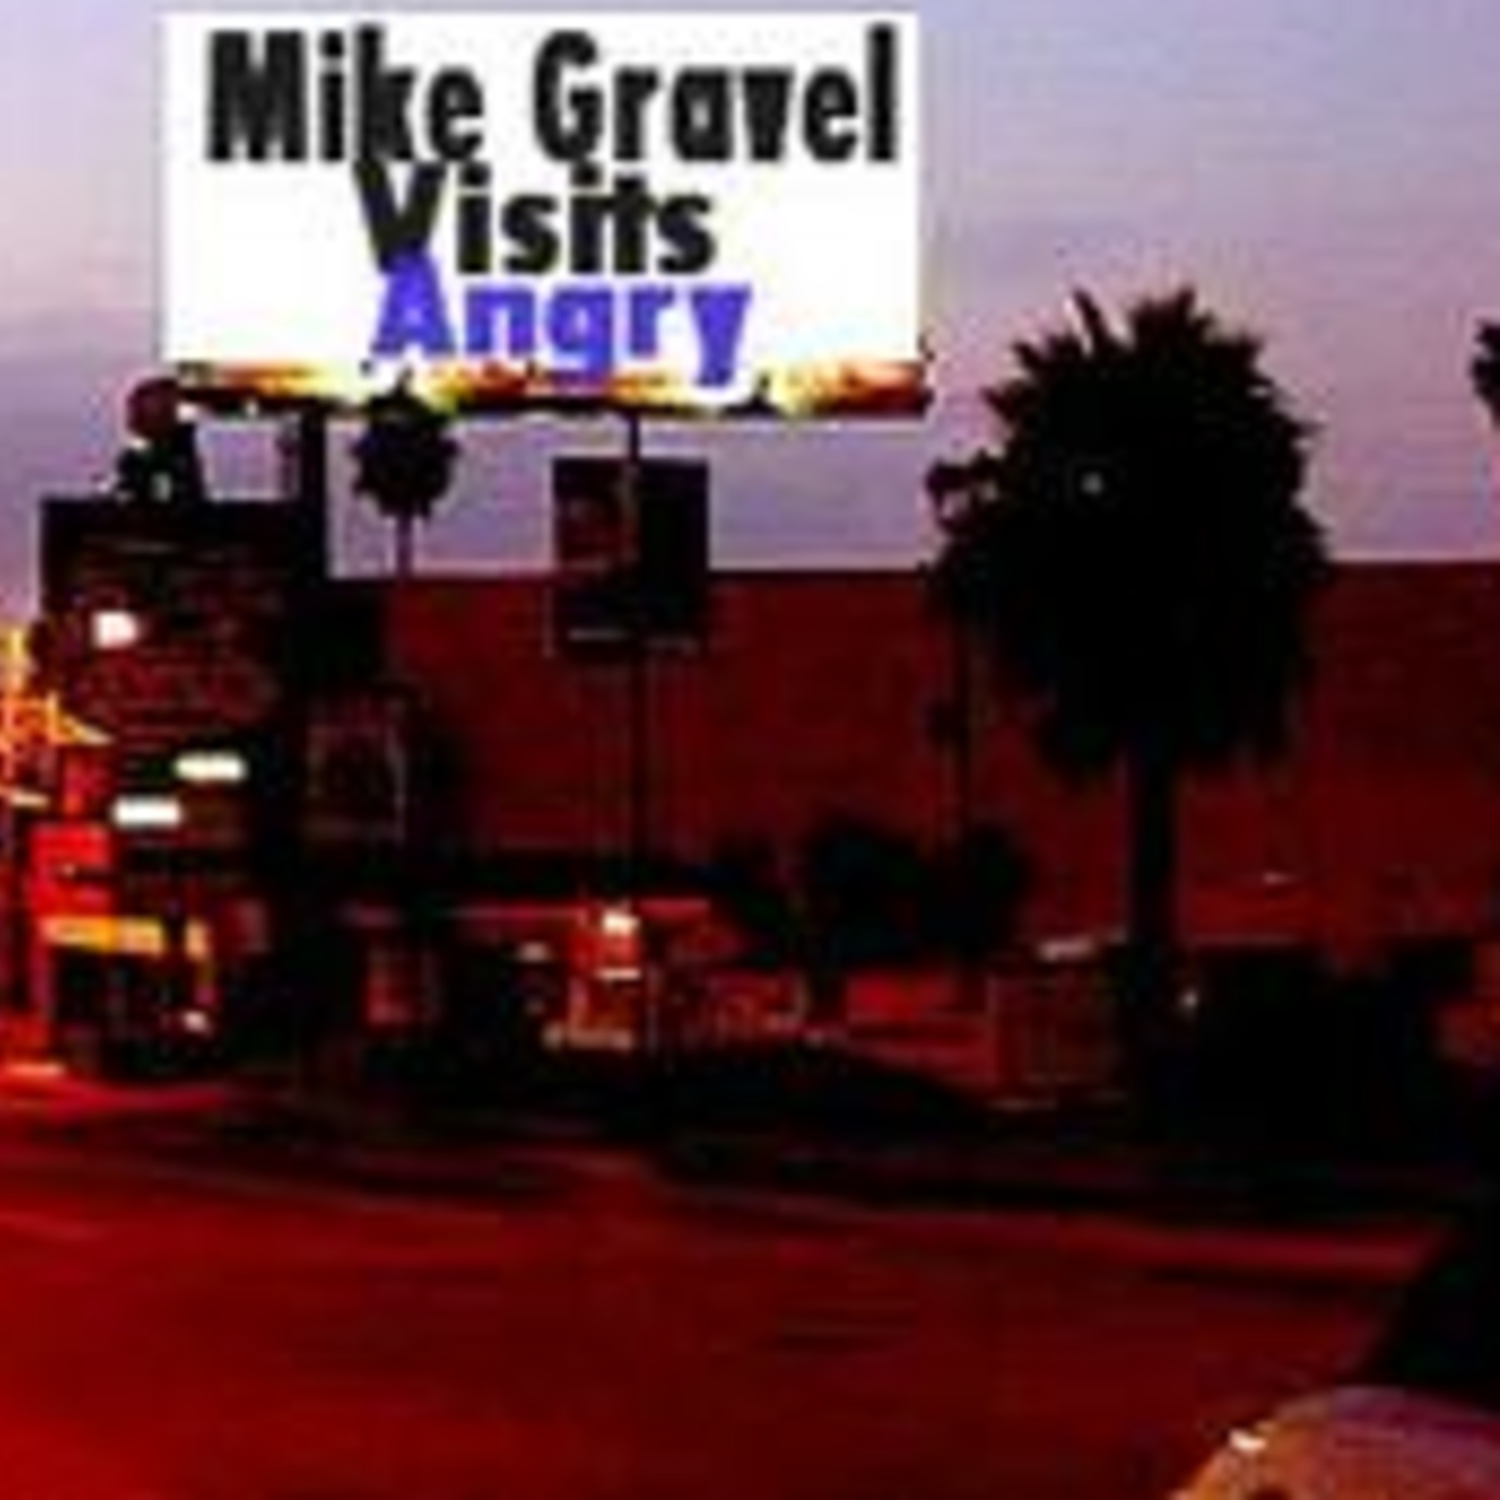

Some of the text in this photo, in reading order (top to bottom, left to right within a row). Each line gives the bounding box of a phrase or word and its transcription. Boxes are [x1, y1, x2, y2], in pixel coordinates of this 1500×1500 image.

[206, 23, 900, 162] Mike Gravel
[352, 161, 717, 275] Visits
[370, 248, 752, 388] Angry
